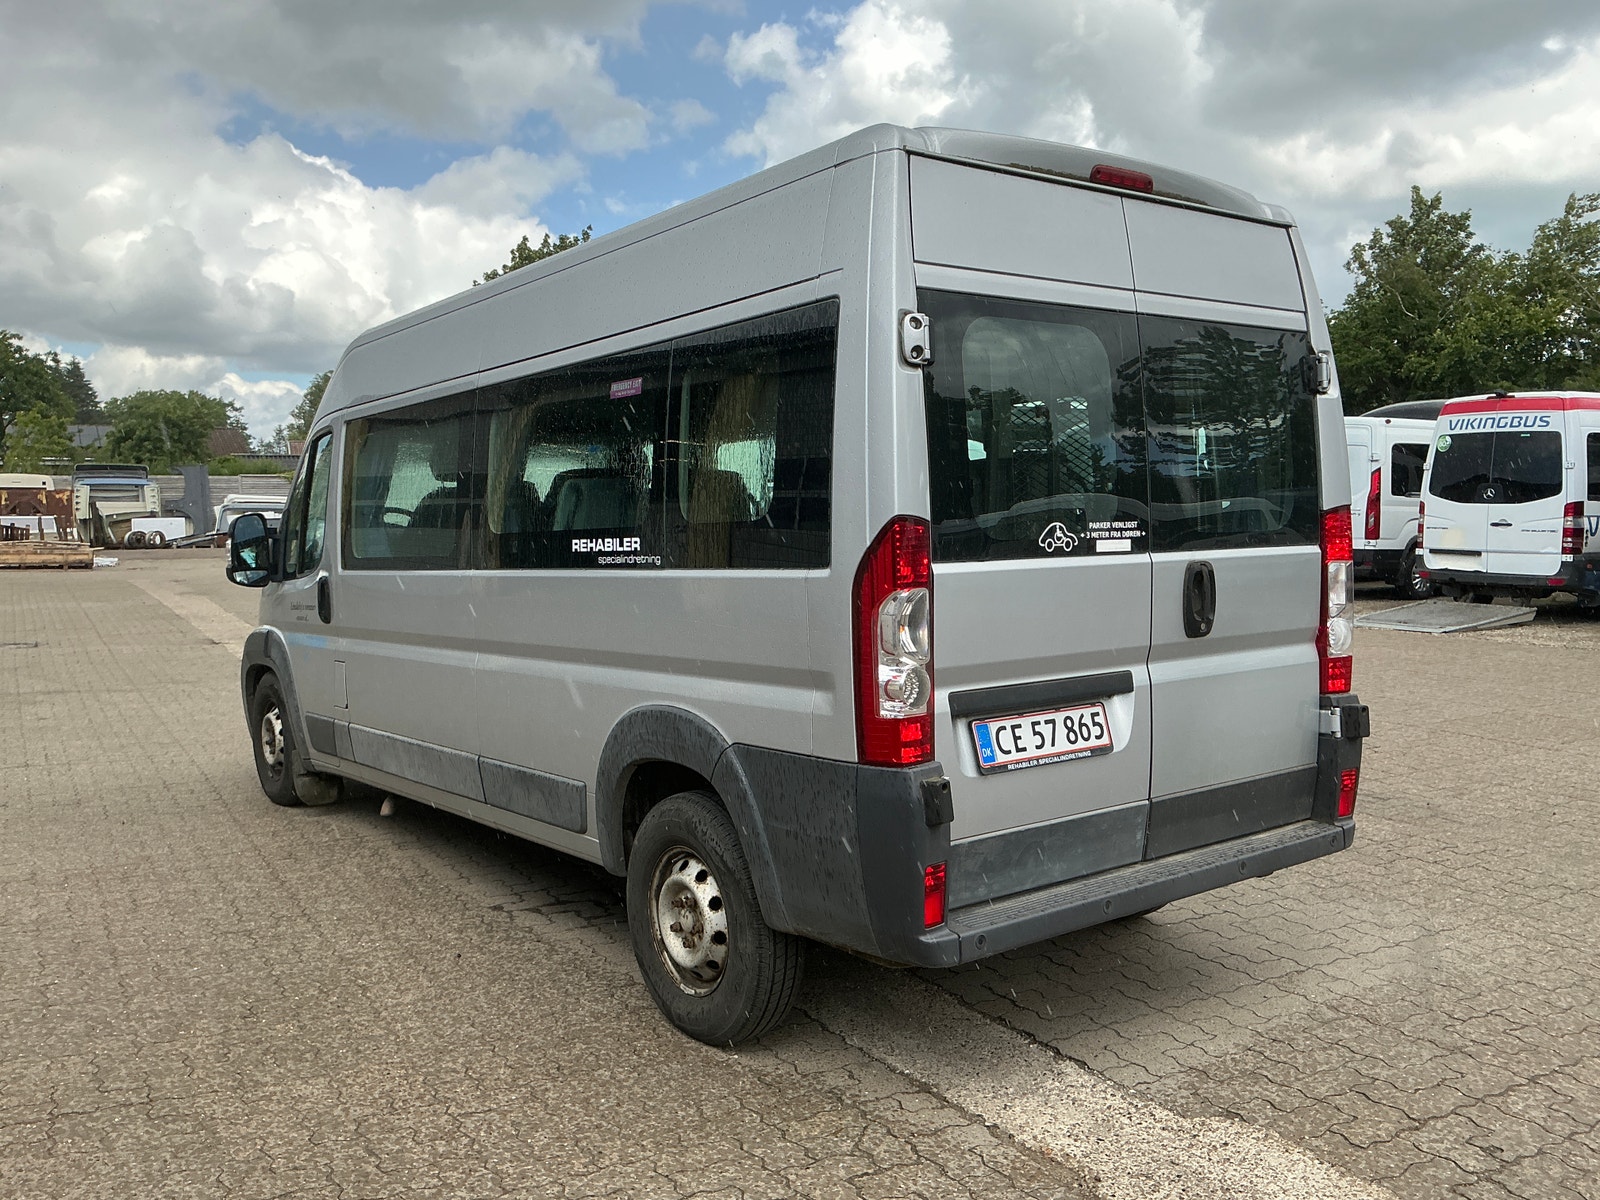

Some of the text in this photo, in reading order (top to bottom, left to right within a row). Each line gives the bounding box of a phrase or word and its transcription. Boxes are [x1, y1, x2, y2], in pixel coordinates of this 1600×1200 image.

[1449, 415, 1551, 431] VIKINGBUS
[1111, 521, 1138, 529] VENLIGST
[571, 537, 641, 552] REHABILER
[598, 554, 661, 565] specialindretning
[995, 712, 1104, 755] CE 57 865
[982, 748, 993, 757] DK
[1008, 750, 1092, 770] REHABILER SPECIALINDRETNING
